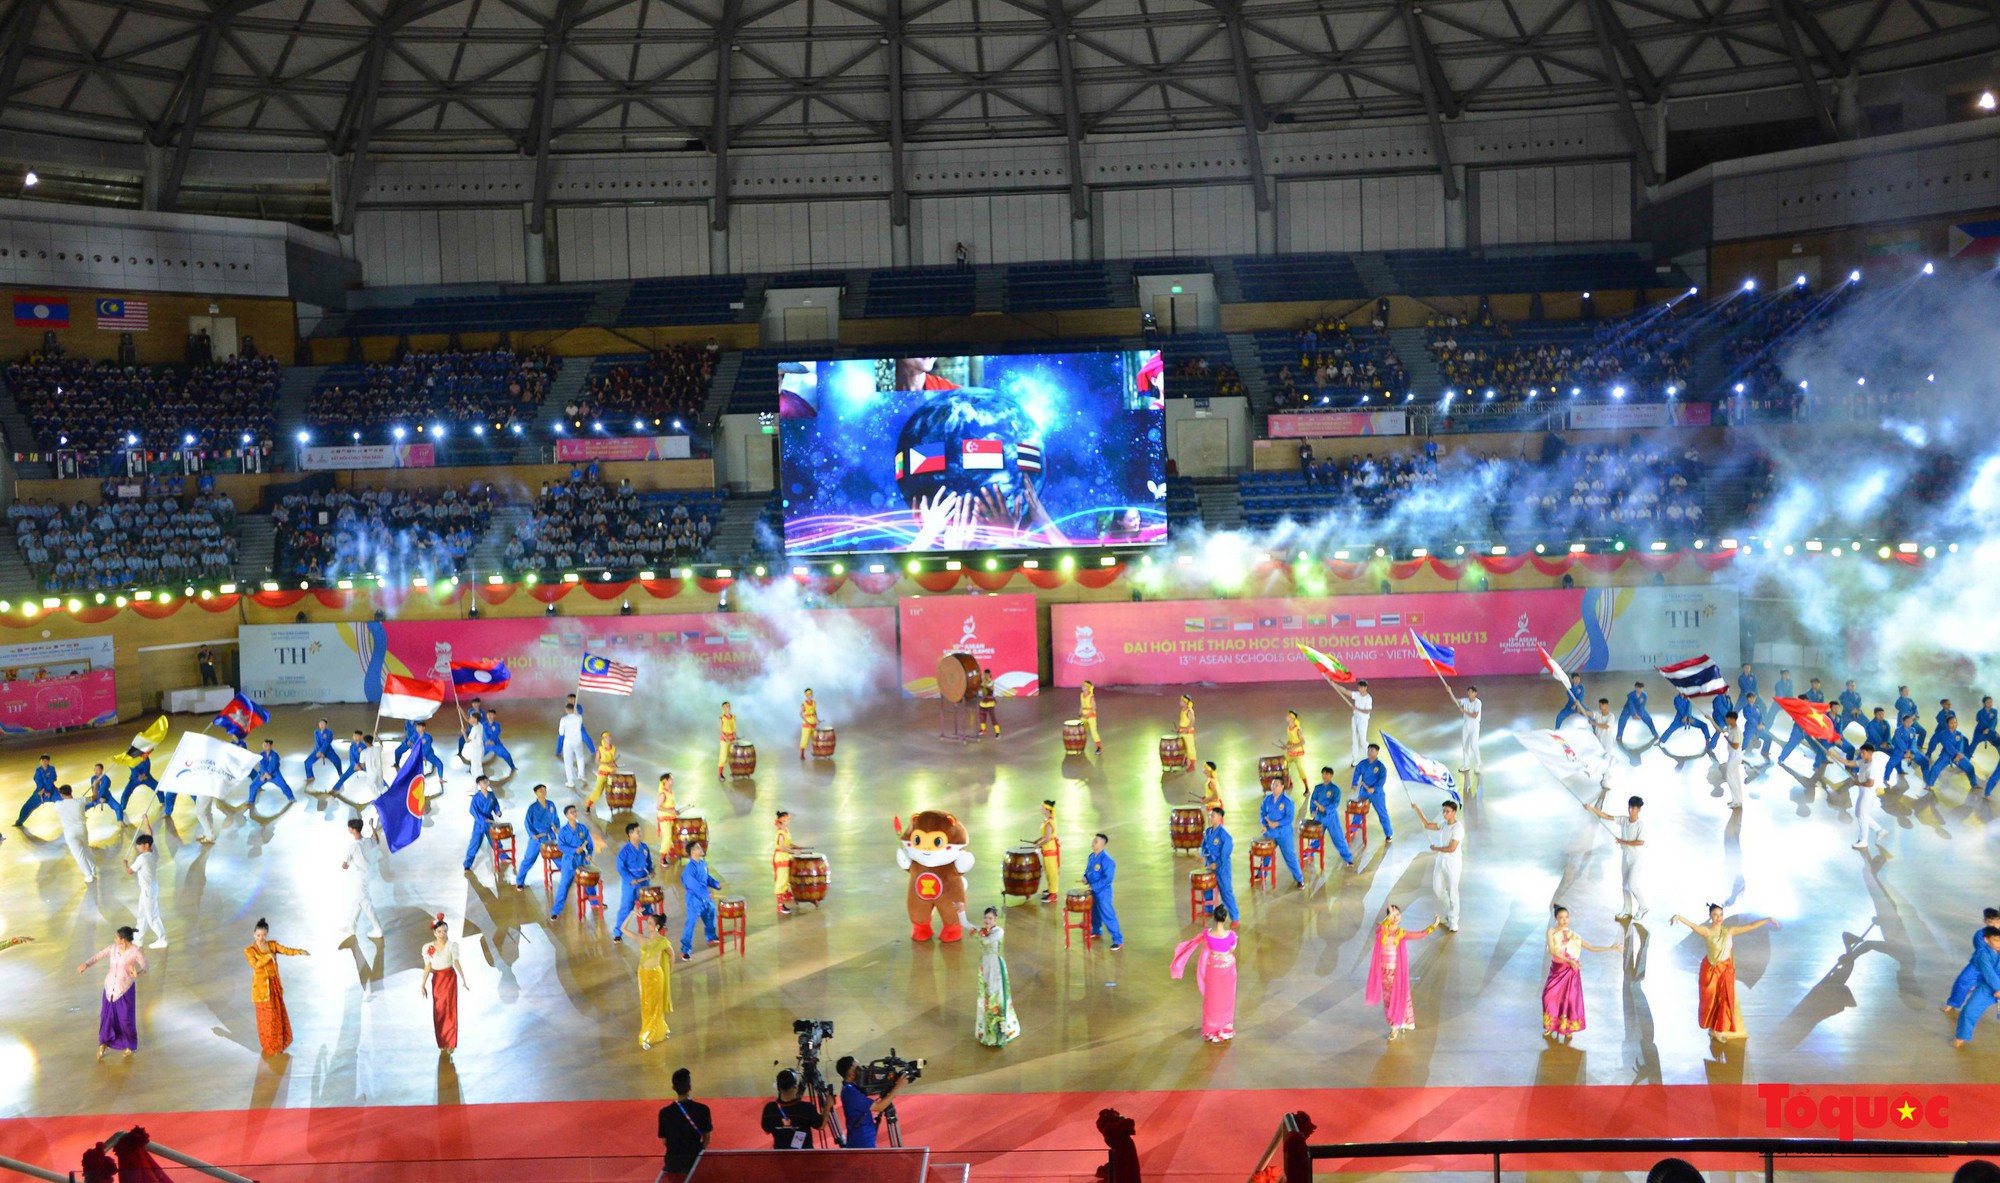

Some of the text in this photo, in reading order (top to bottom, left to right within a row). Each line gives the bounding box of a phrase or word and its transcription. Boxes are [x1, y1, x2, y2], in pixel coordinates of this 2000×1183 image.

[1665, 610, 1699, 628] TH
[1123, 641, 1147, 656] ĐẠI
[1150, 639, 1177, 655] HỘI
[1207, 638, 1246, 652] THAO
[1248, 638, 1280, 651] HỌC
[1318, 634, 1361, 648] ĐÔNG
[1363, 633, 1398, 647] NAM
[1474, 631, 1488, 644] 13
[274, 647, 306, 664] TH
[1199, 654, 1233, 665] ASEAN
[1235, 652, 1285, 664] SCHOOLS
[1345, 650, 1378, 661] NANG
